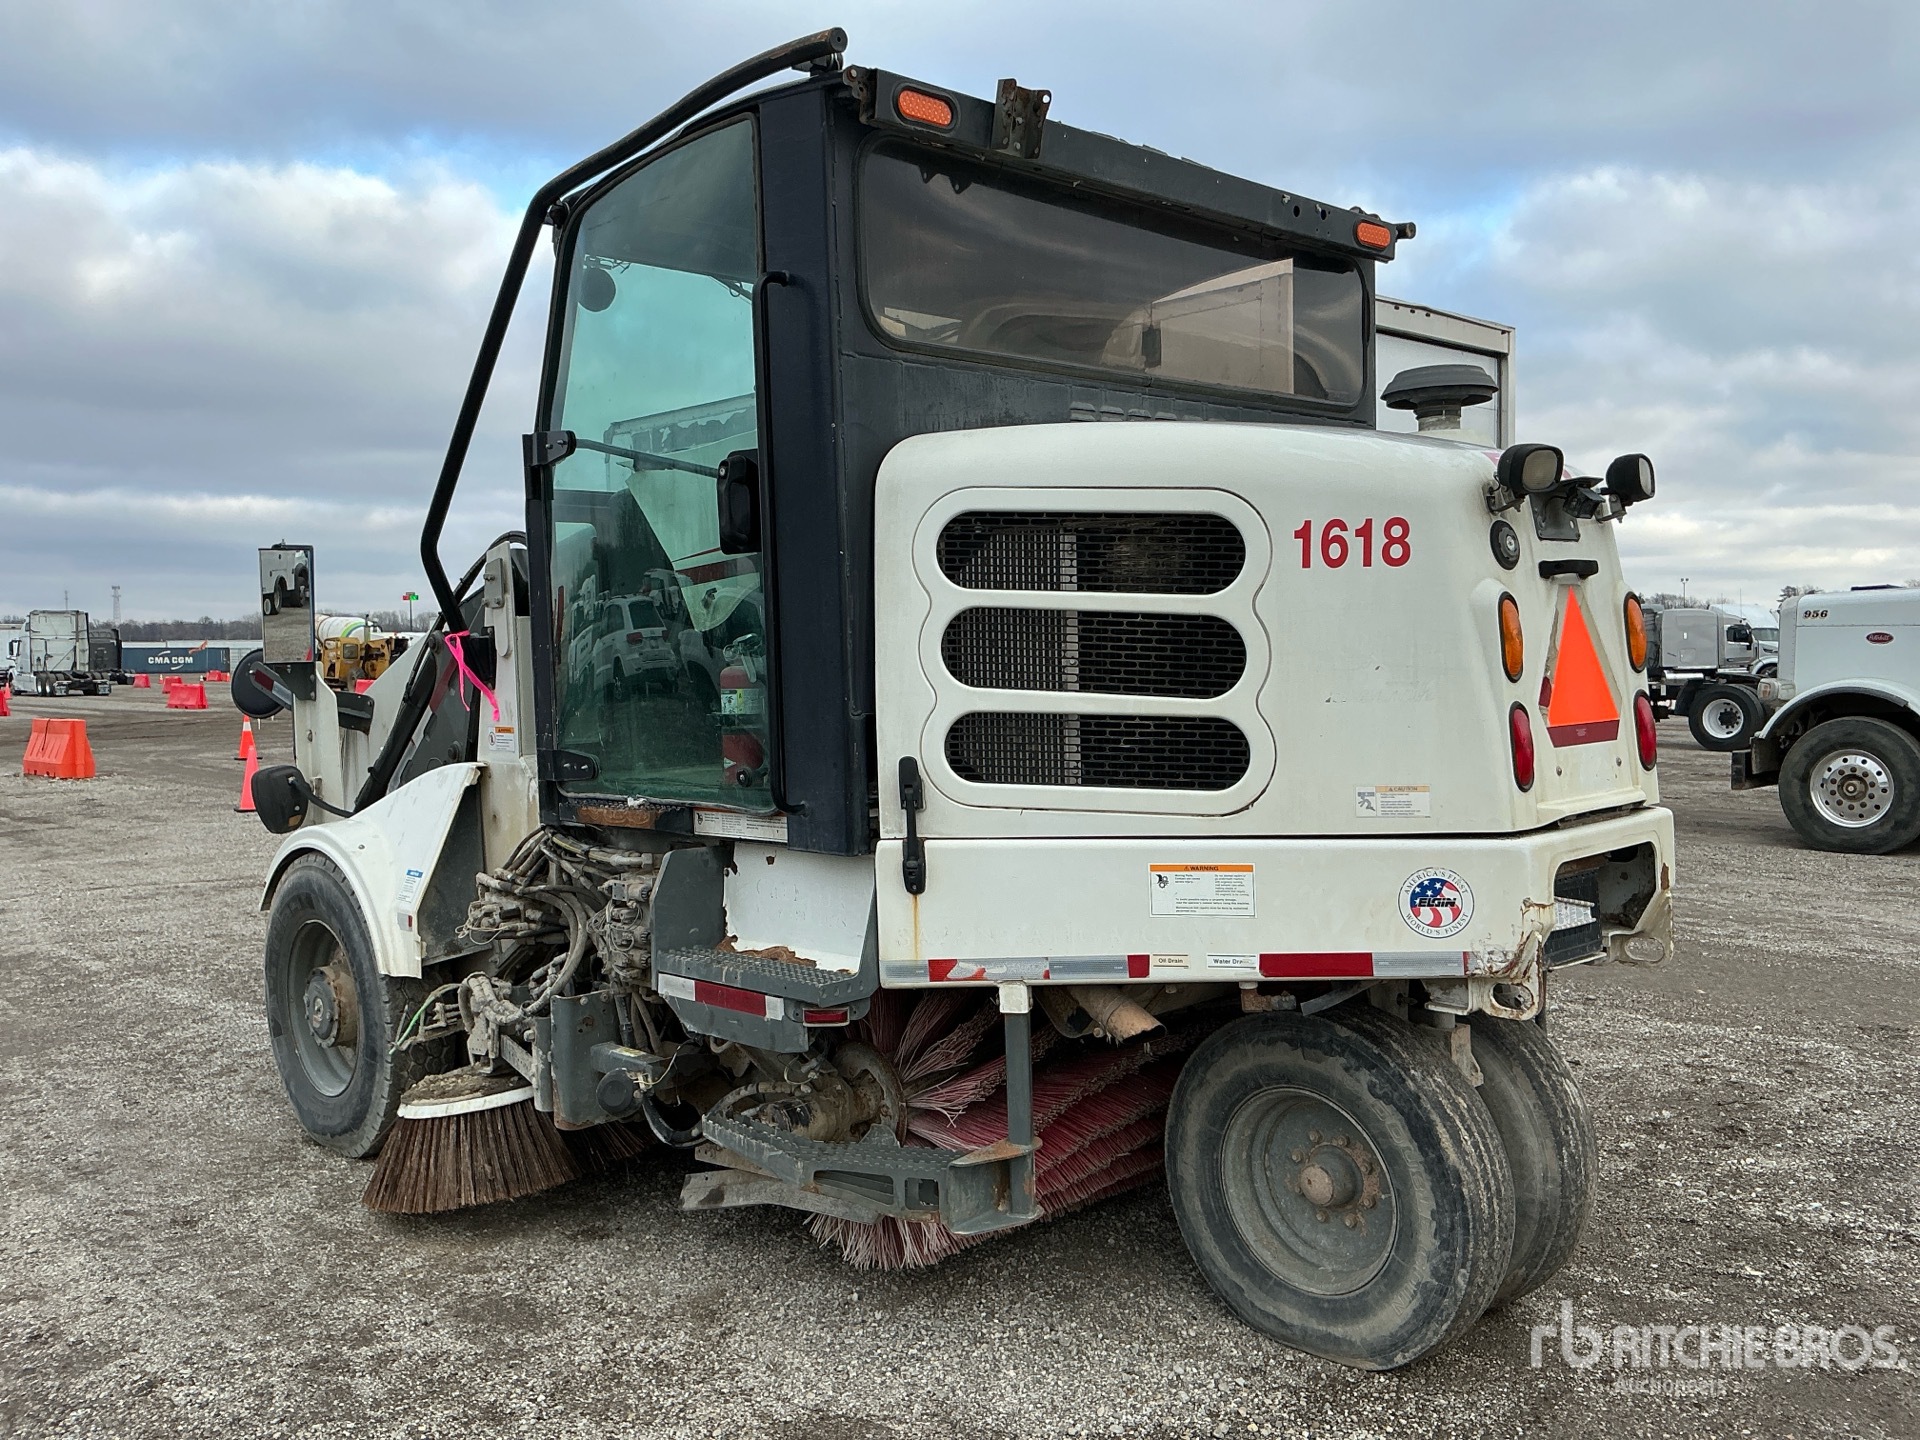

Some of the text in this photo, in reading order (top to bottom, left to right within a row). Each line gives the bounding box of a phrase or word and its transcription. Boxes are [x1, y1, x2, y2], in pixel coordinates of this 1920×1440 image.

[1294, 516, 1412, 569] 1618
[1803, 609, 1828, 619] 956
[148, 656, 193, 664] CMA CGM
[1404, 870, 1468, 895] AMERICA'S FIRST
[1417, 896, 1457, 908] ELGIN
[1405, 912, 1469, 935] WORLD'S FINEST
